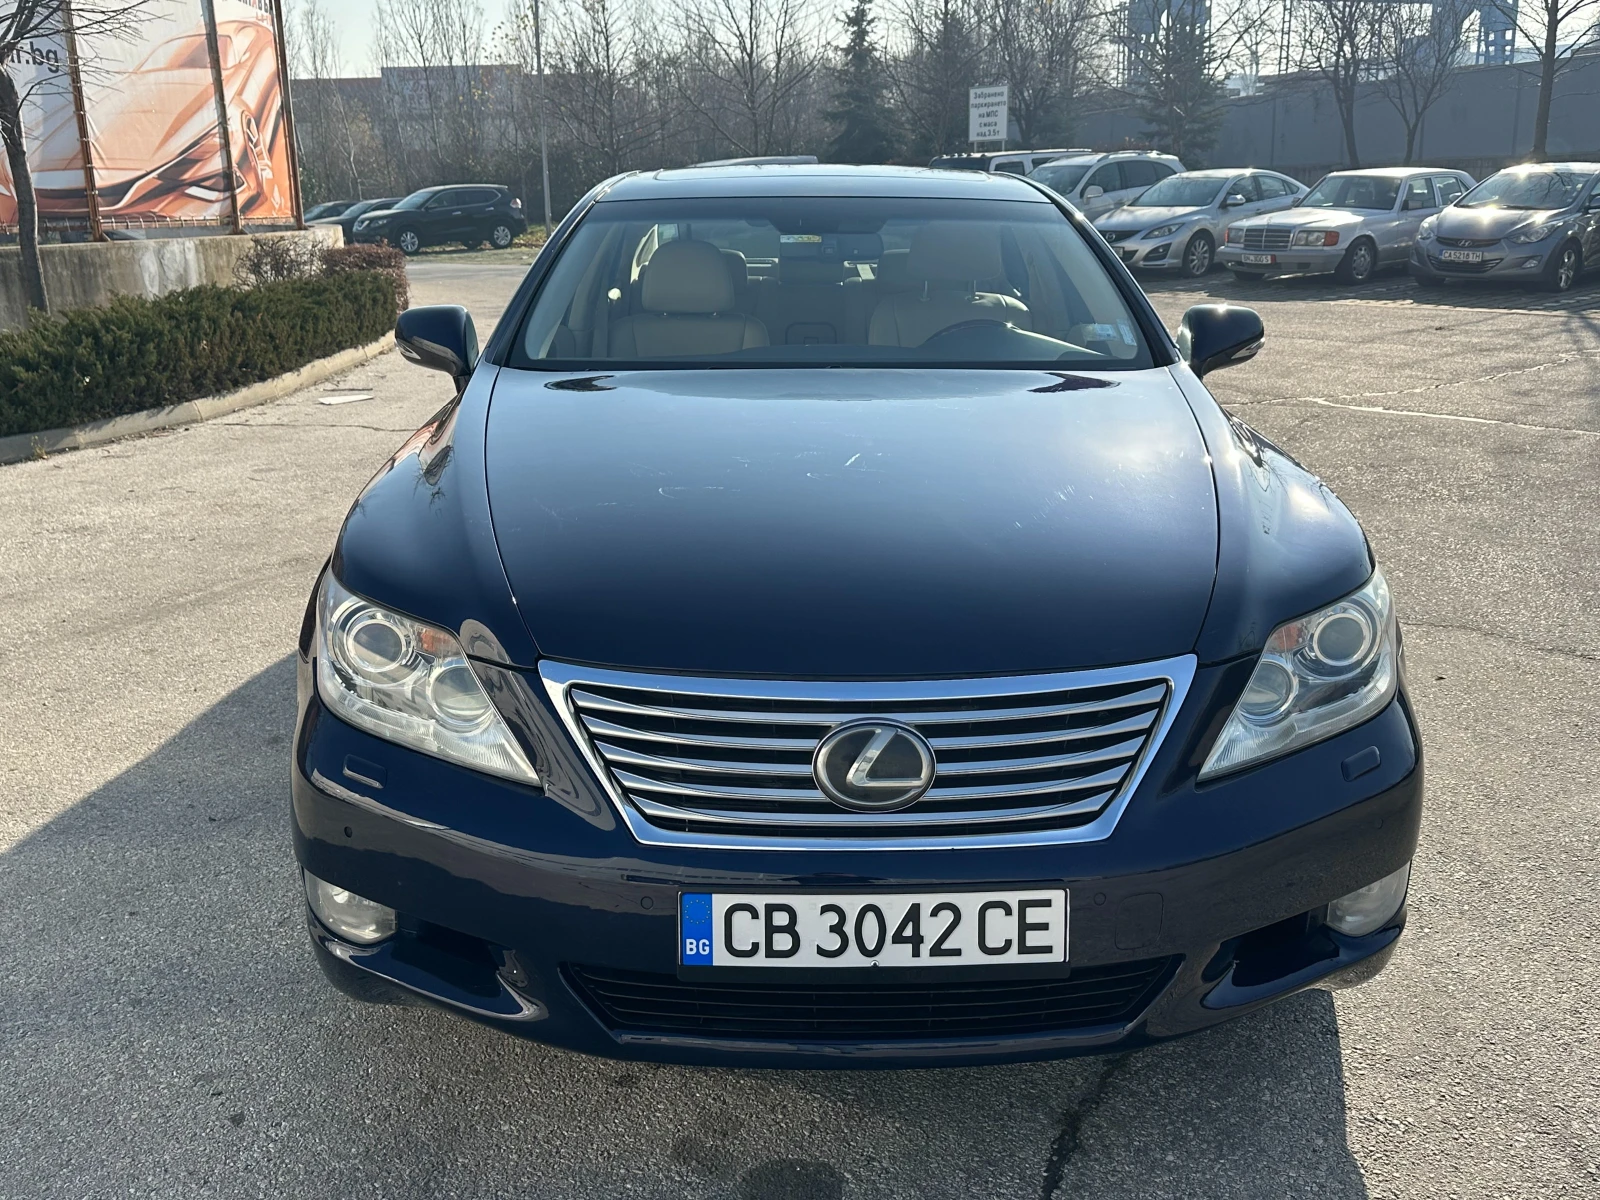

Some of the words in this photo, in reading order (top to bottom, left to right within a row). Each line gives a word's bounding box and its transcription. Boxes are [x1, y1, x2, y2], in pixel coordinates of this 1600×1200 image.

[973, 91, 1004, 99] Забранено
[970, 100, 1007, 109] паркирането
[986, 110, 999, 118] МПС
[1443, 251, 1452, 259] CA
[1471, 252, 1481, 260] TH
[723, 902, 801, 959] CB
[816, 902, 963, 959] 3042
[977, 898, 1054, 956] CE
[685, 938, 711, 955] BG
